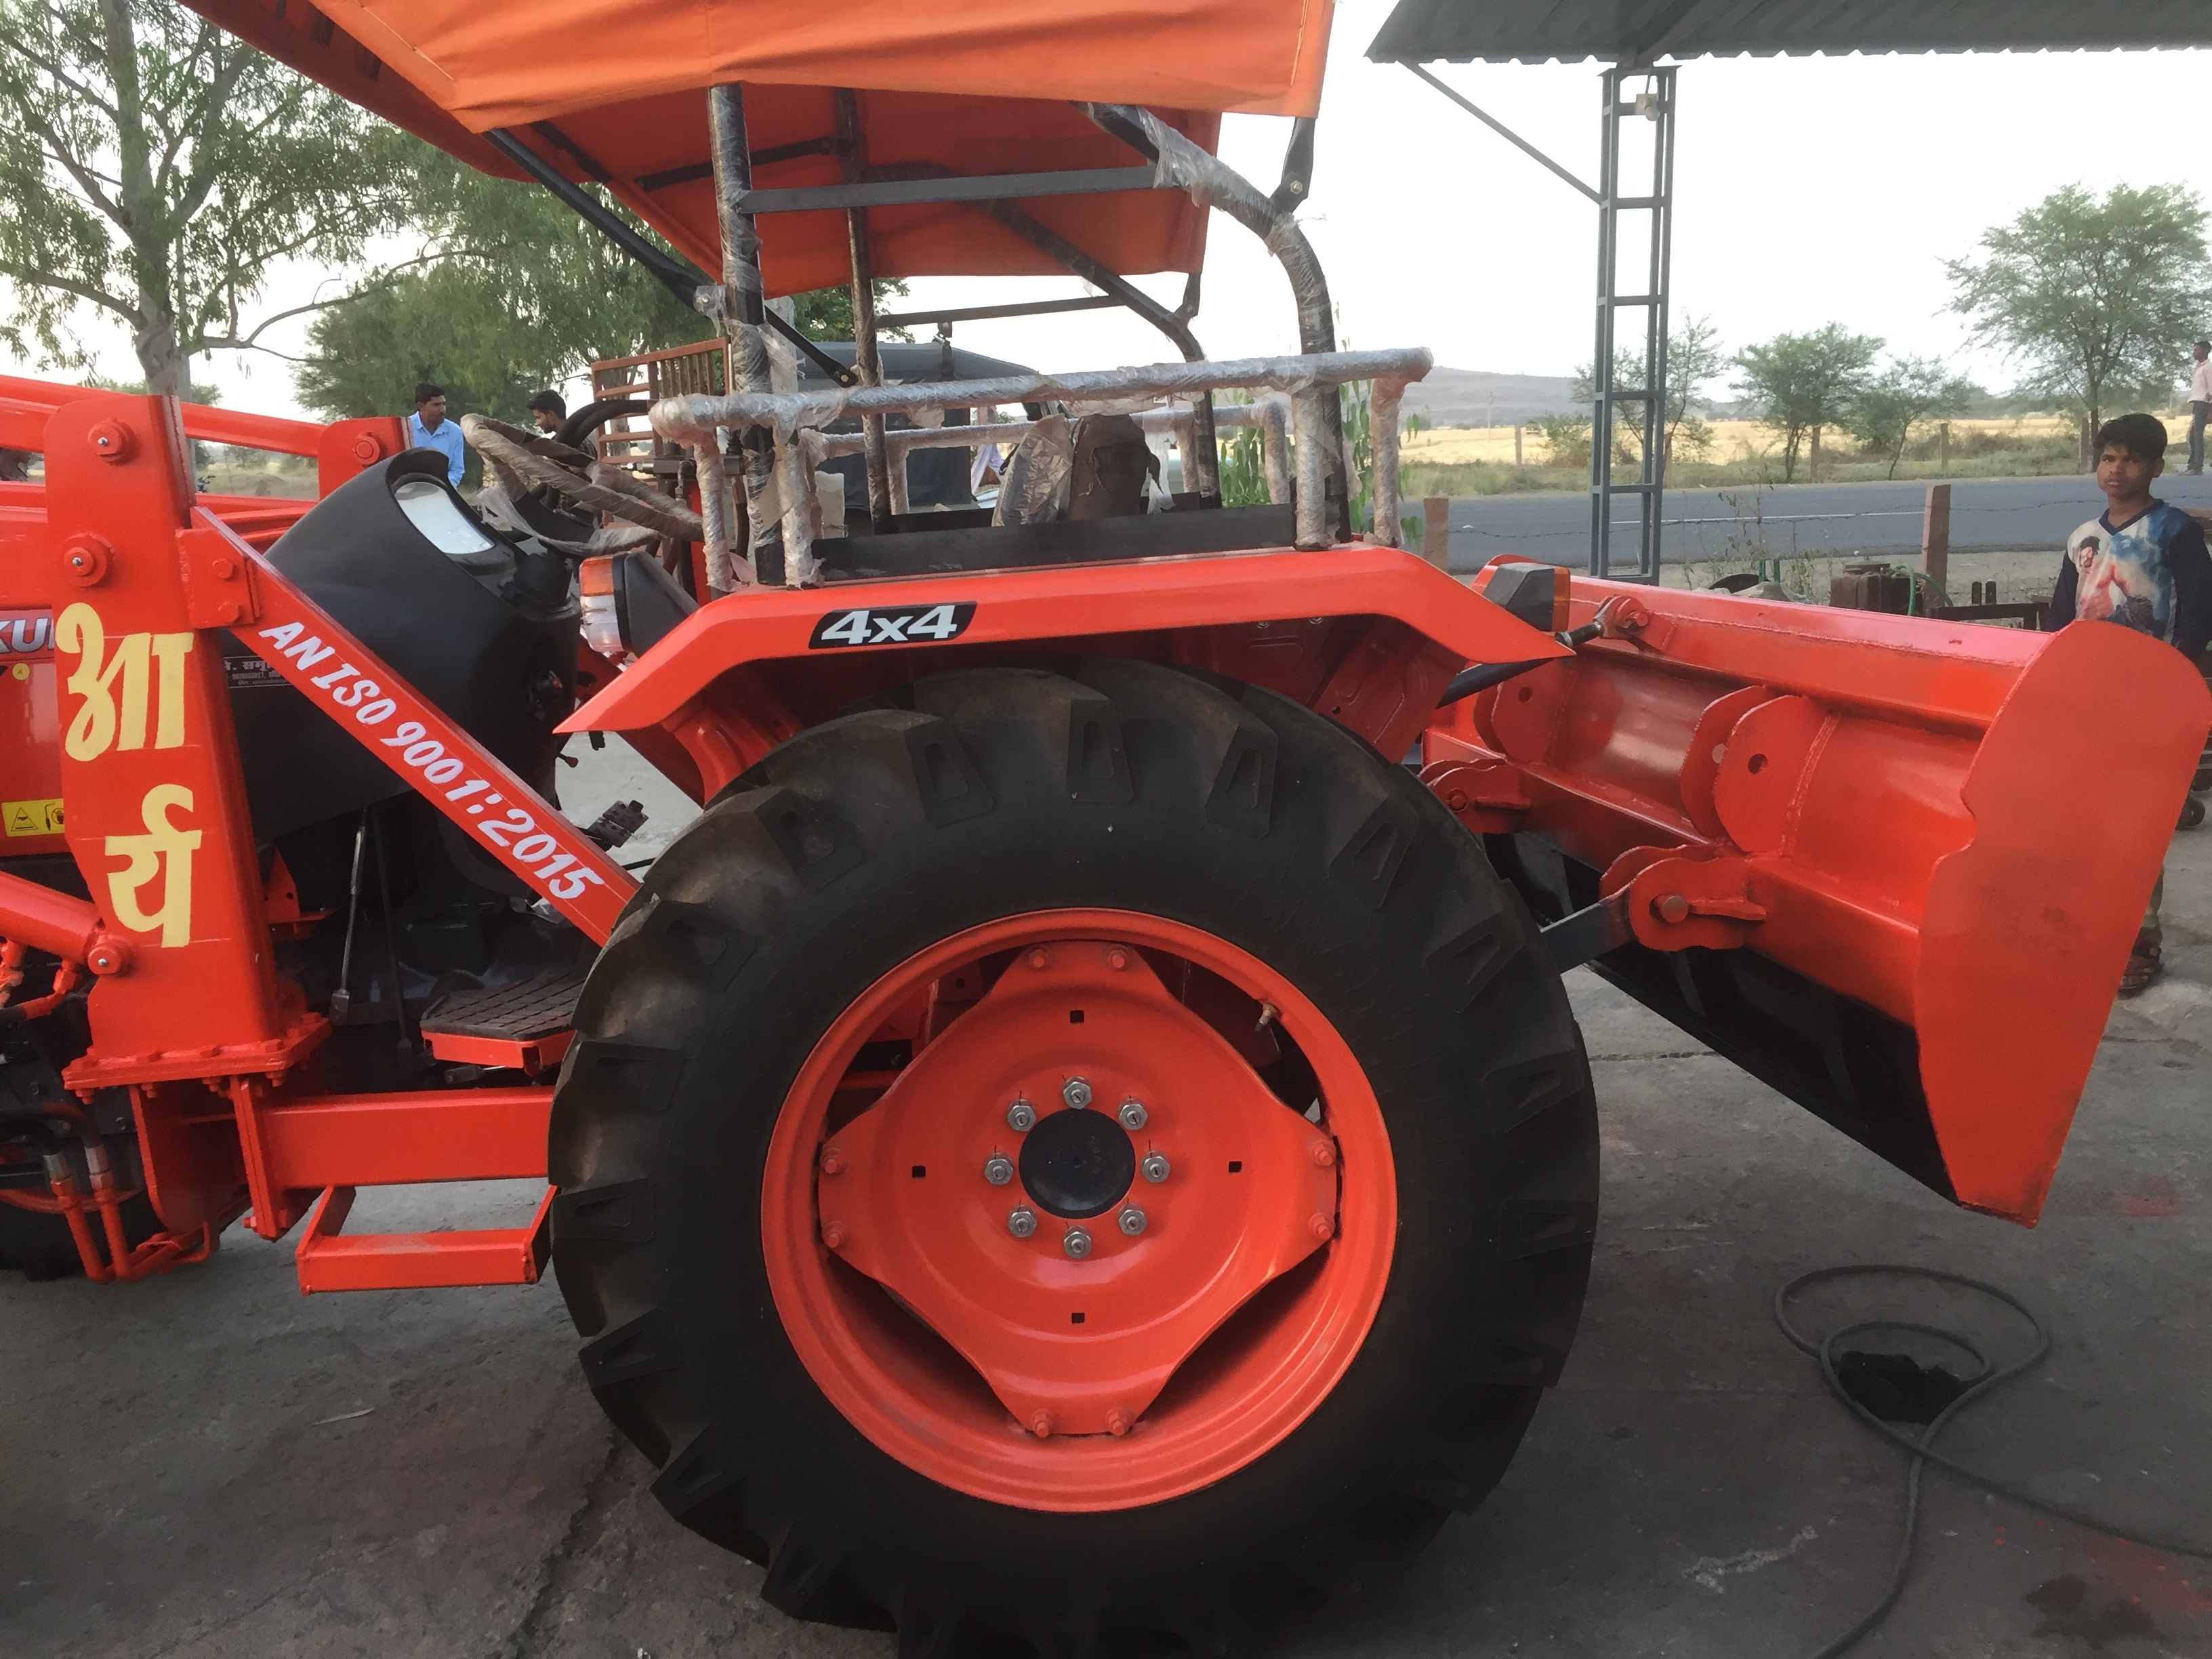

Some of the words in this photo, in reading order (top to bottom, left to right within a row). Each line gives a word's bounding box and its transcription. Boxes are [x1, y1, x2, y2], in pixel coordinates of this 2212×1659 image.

[821, 605, 958, 644] 4x4
[258, 621, 335, 671] AN
[310, 663, 397, 725] ISO
[380, 721, 605, 899] 9001:2015
